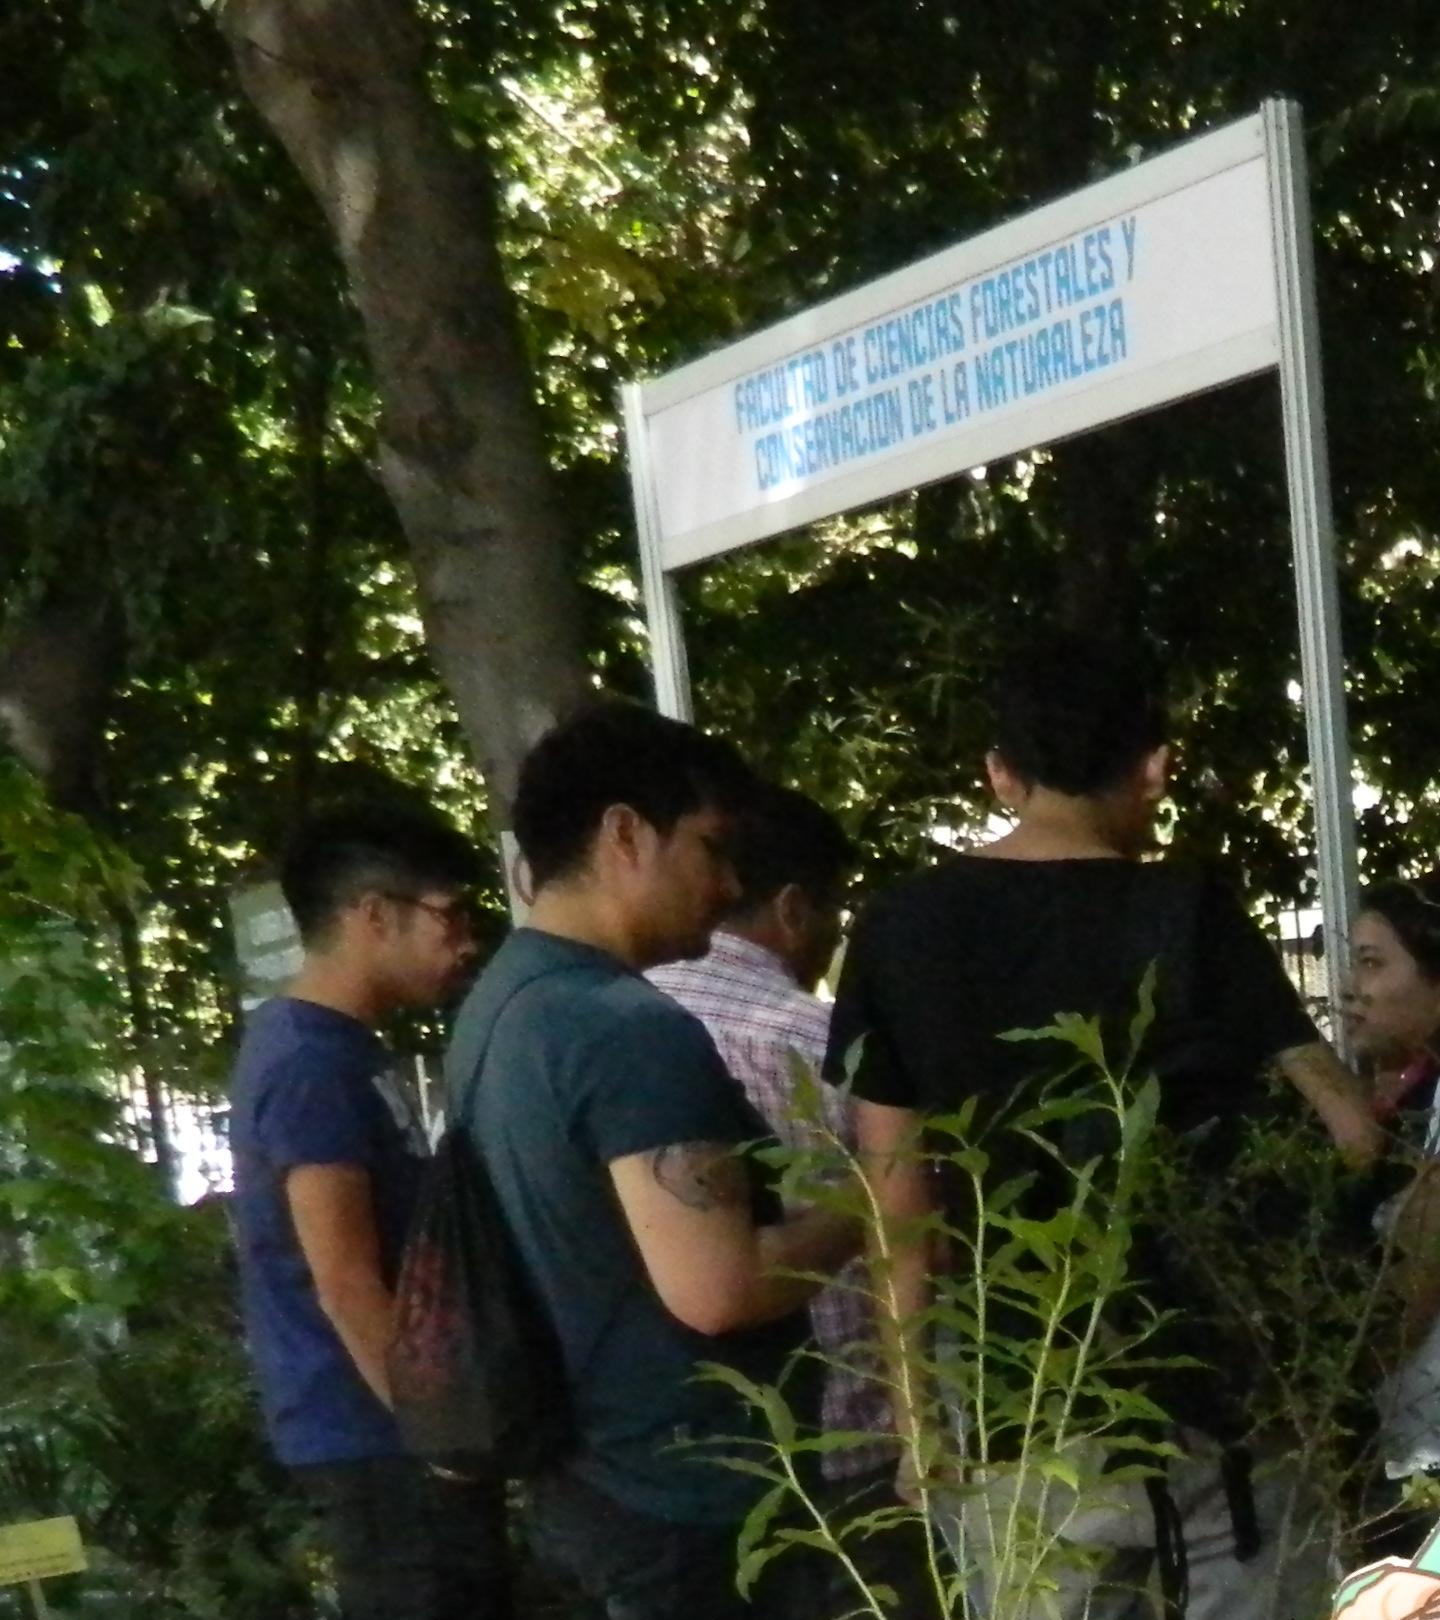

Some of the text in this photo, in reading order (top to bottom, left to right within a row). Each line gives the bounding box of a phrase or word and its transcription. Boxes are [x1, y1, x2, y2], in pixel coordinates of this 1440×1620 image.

[735, 215, 1136, 434] FACULTAD DE CIENCIAS FORESTALES Y
[755, 296, 1127, 491] CONSERVACION DE LA NATURALEZA
